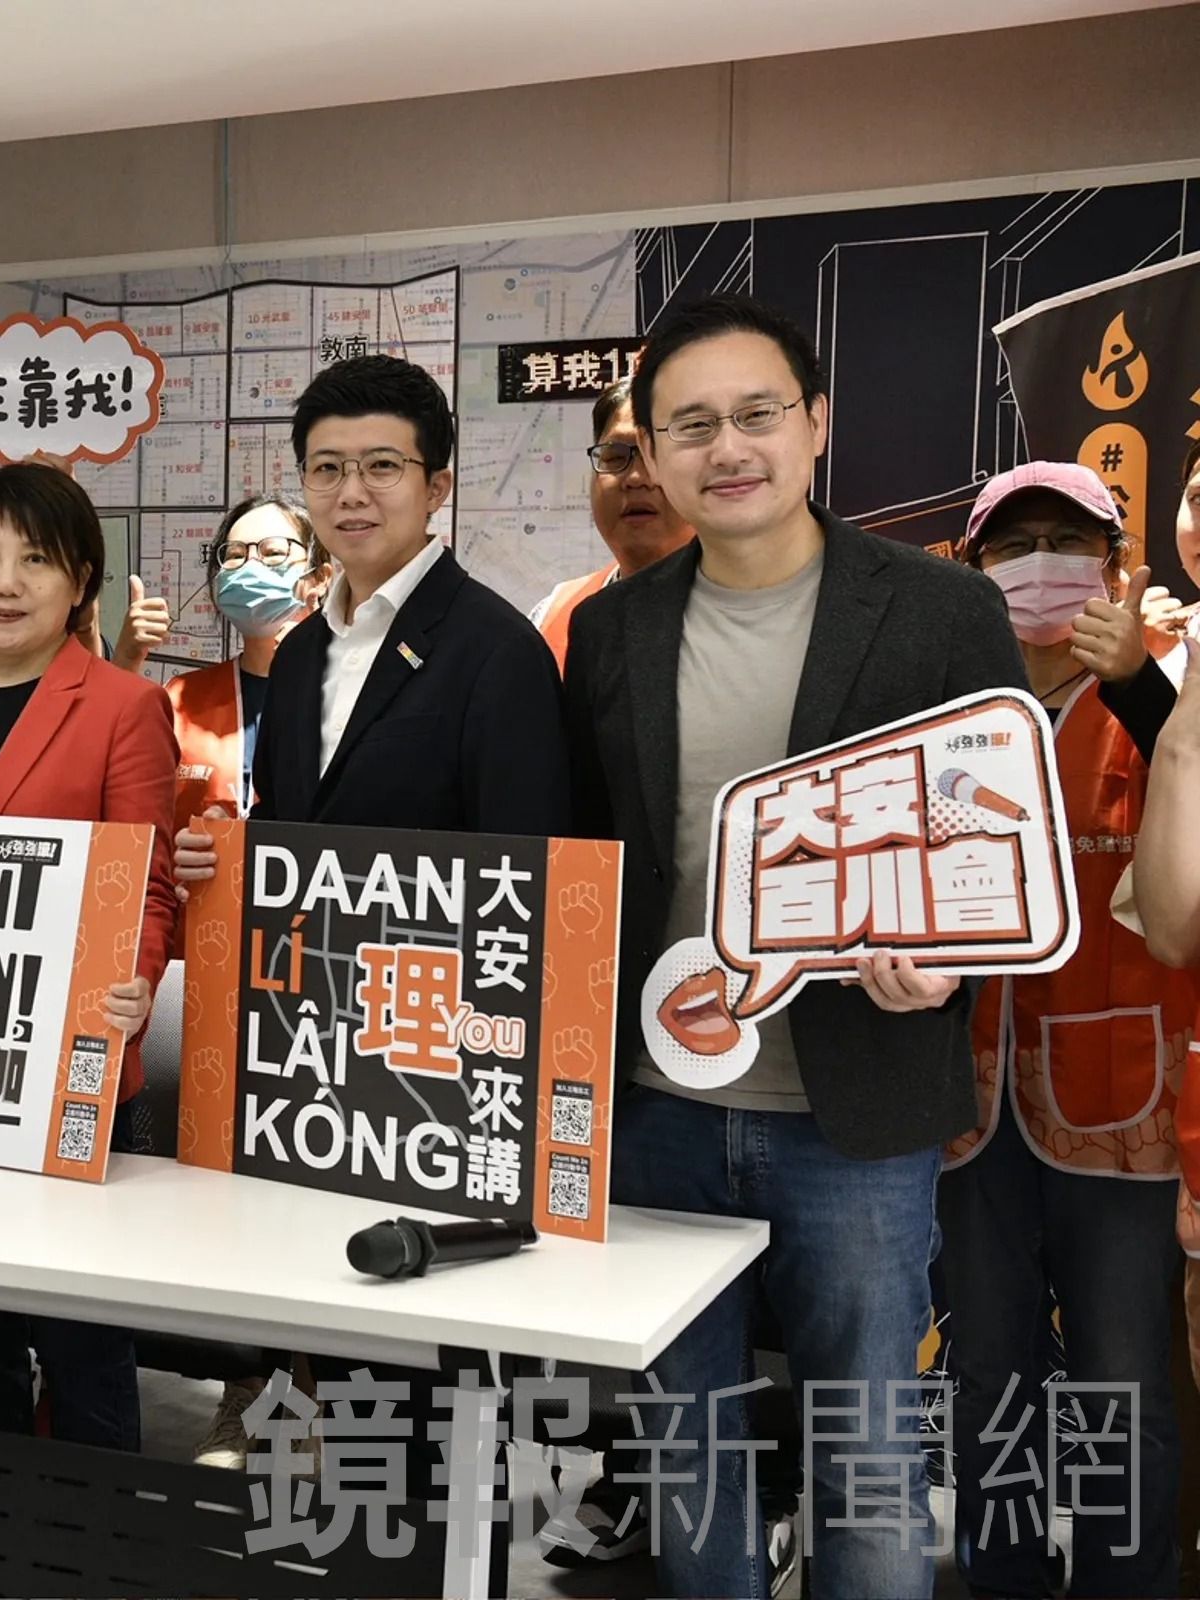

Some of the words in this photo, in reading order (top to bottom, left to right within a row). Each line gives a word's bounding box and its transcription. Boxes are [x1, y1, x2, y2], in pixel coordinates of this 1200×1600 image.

[320, 336, 368, 361] 敦南
[756, 746, 927, 868] 大安
[252, 844, 465, 925] DAAN
[474, 855, 533, 993] 大安
[249, 914, 306, 995] LÍ
[246, 999, 348, 1087] LÂI
[354, 942, 464, 1079] 理
[436, 1002, 526, 1060] You
[243, 1086, 461, 1192] KÓNG
[465, 1066, 526, 1206] 來講
